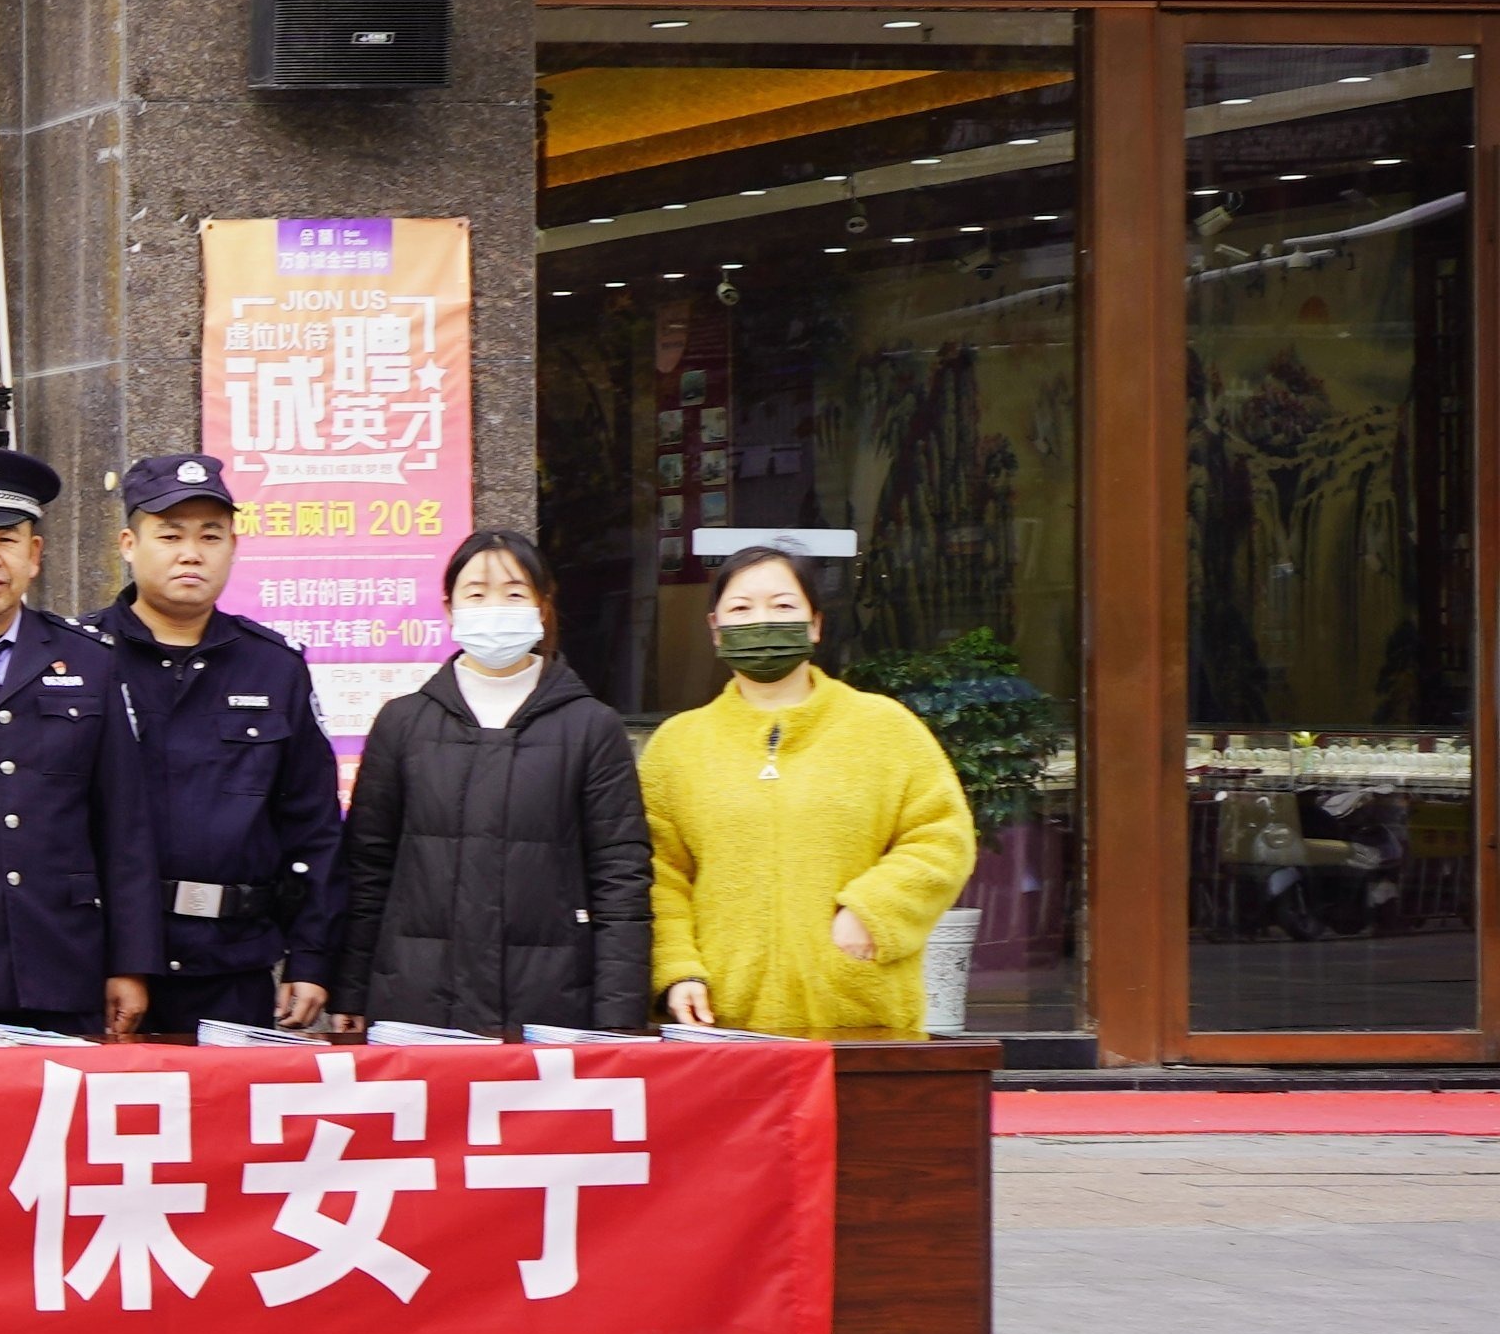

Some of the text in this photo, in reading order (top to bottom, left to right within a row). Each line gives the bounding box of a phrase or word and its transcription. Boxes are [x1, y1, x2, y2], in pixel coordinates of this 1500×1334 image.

[280, 289, 388, 312] JION US
[224, 322, 330, 351] 虚位以待
[331, 392, 447, 451] 英才
[234, 499, 443, 537] 珠宝顾问 20名
[258, 578, 417, 607] 有良好的晋升空间
